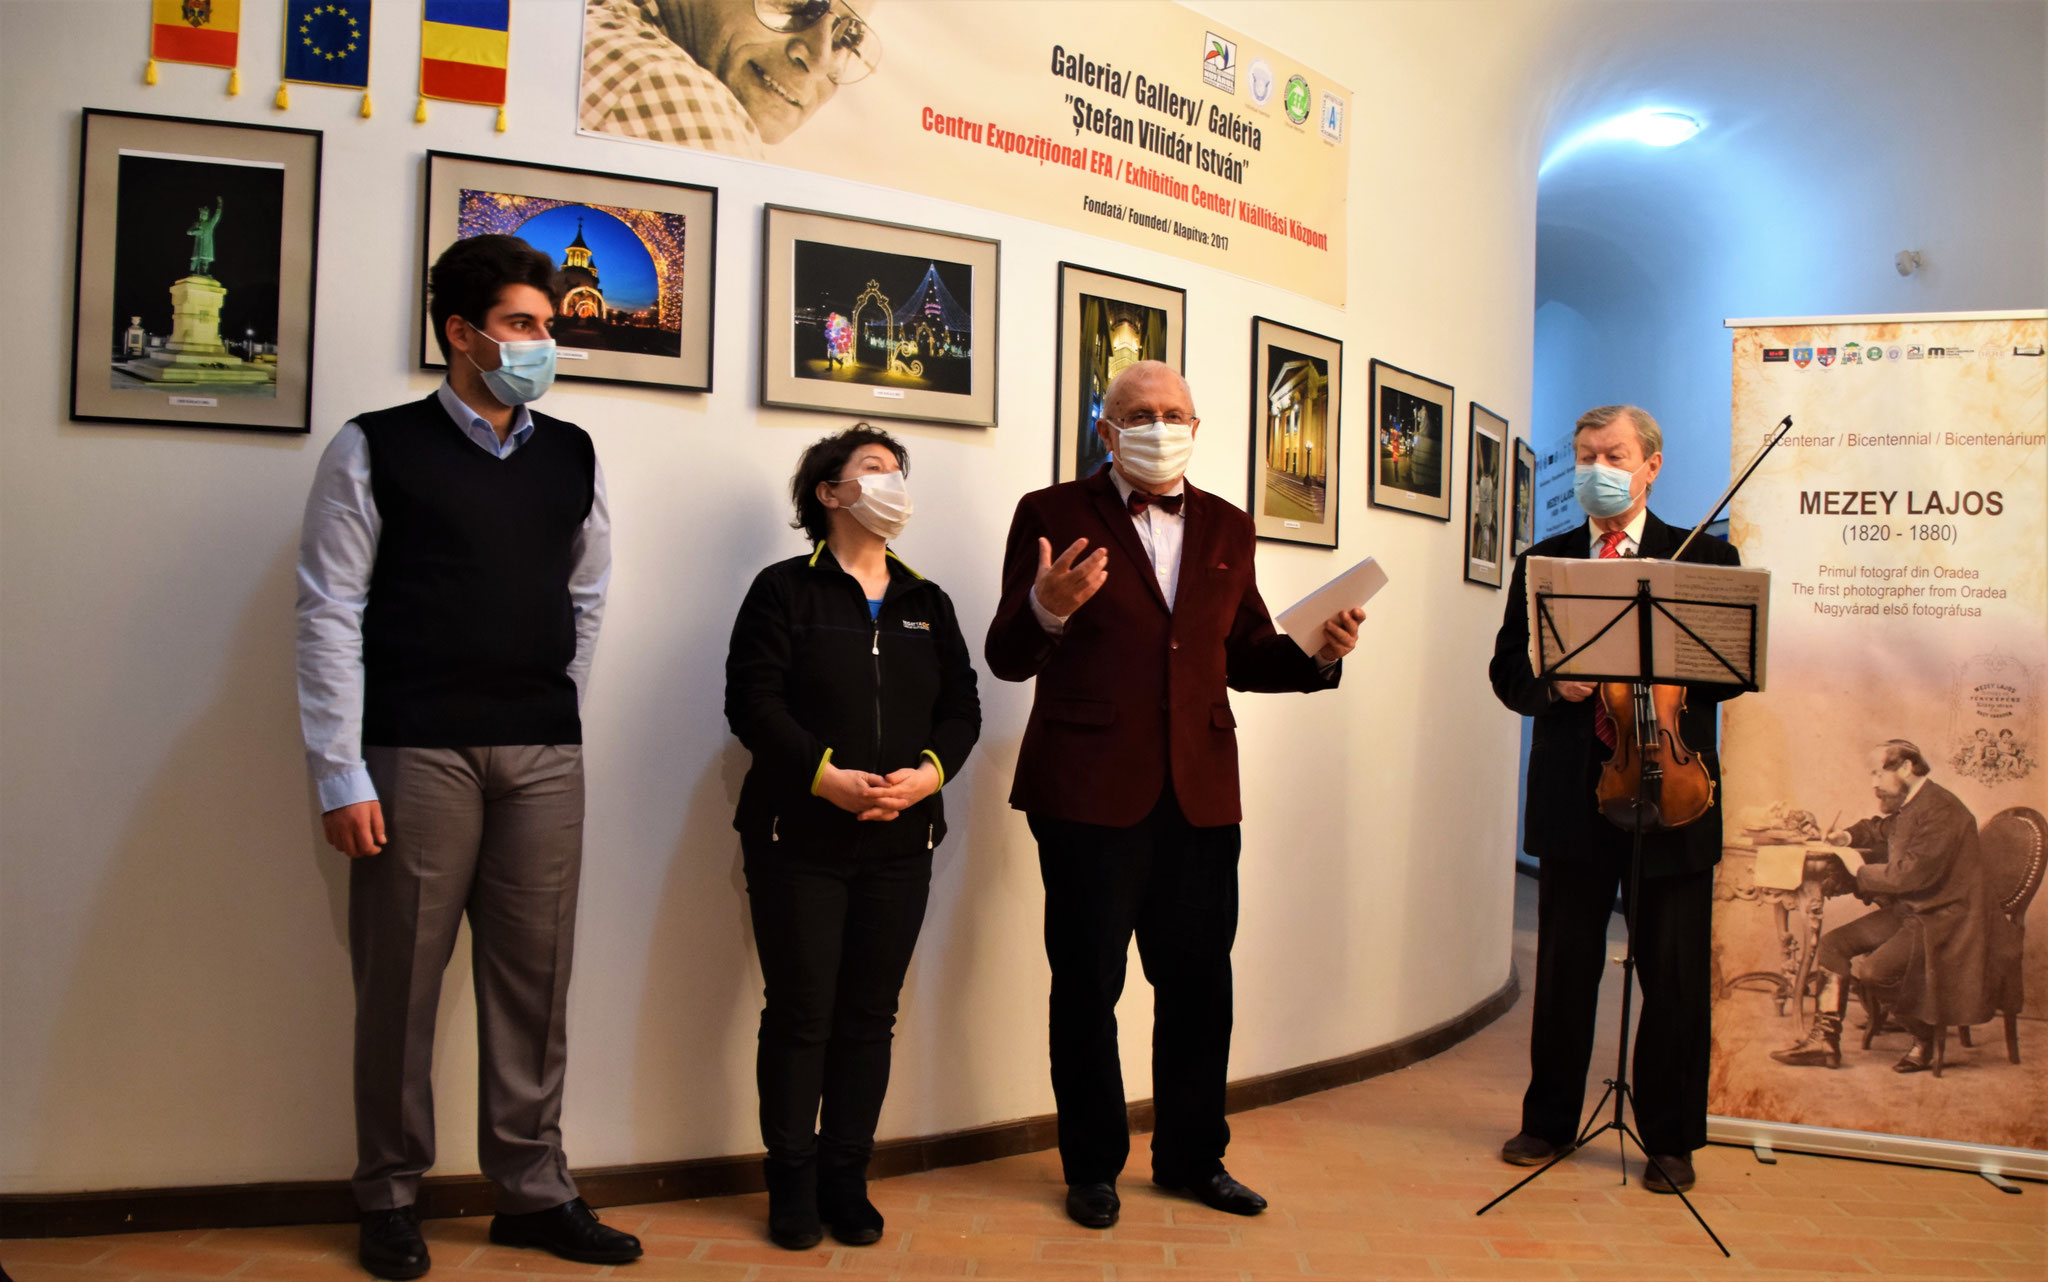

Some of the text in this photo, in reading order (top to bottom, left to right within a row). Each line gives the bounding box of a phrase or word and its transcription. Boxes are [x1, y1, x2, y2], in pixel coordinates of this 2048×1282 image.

[1051, 45, 1131, 98] Galeria/
[1135, 74, 1203, 126] Gallery/
[1208, 104, 1261, 151] Galéria
[1138, 118, 1192, 165] Vilidár
[922, 106, 983, 144] Centru
[986, 122, 1088, 171] Expozițional
[1090, 149, 1113, 179] EFA
[1115, 158, 1123, 181] /
[1125, 161, 1188, 203] Exhibition
[1191, 184, 1237, 218] Center/
[1290, 219, 1328, 252] Központ
[1083, 195, 1128, 221] Fondată/
[1128, 207, 1172, 234] Founded/
[1211, 232, 1229, 251] 2017
[1763, 432, 2046, 448] Bicentenar / Bicentennial / Bicentenárium
[1799, 490, 2004, 516] MEZEY LAJOS
[1842, 524, 1891, 546] (1820
[1910, 524, 1957, 546] 1880)
[1818, 564, 1980, 581] Primul fotograf din Oradea
[1792, 582, 2007, 600] The first photographer from Oradea
[1813, 601, 1982, 619] Nagyvárad első fotográfusa
